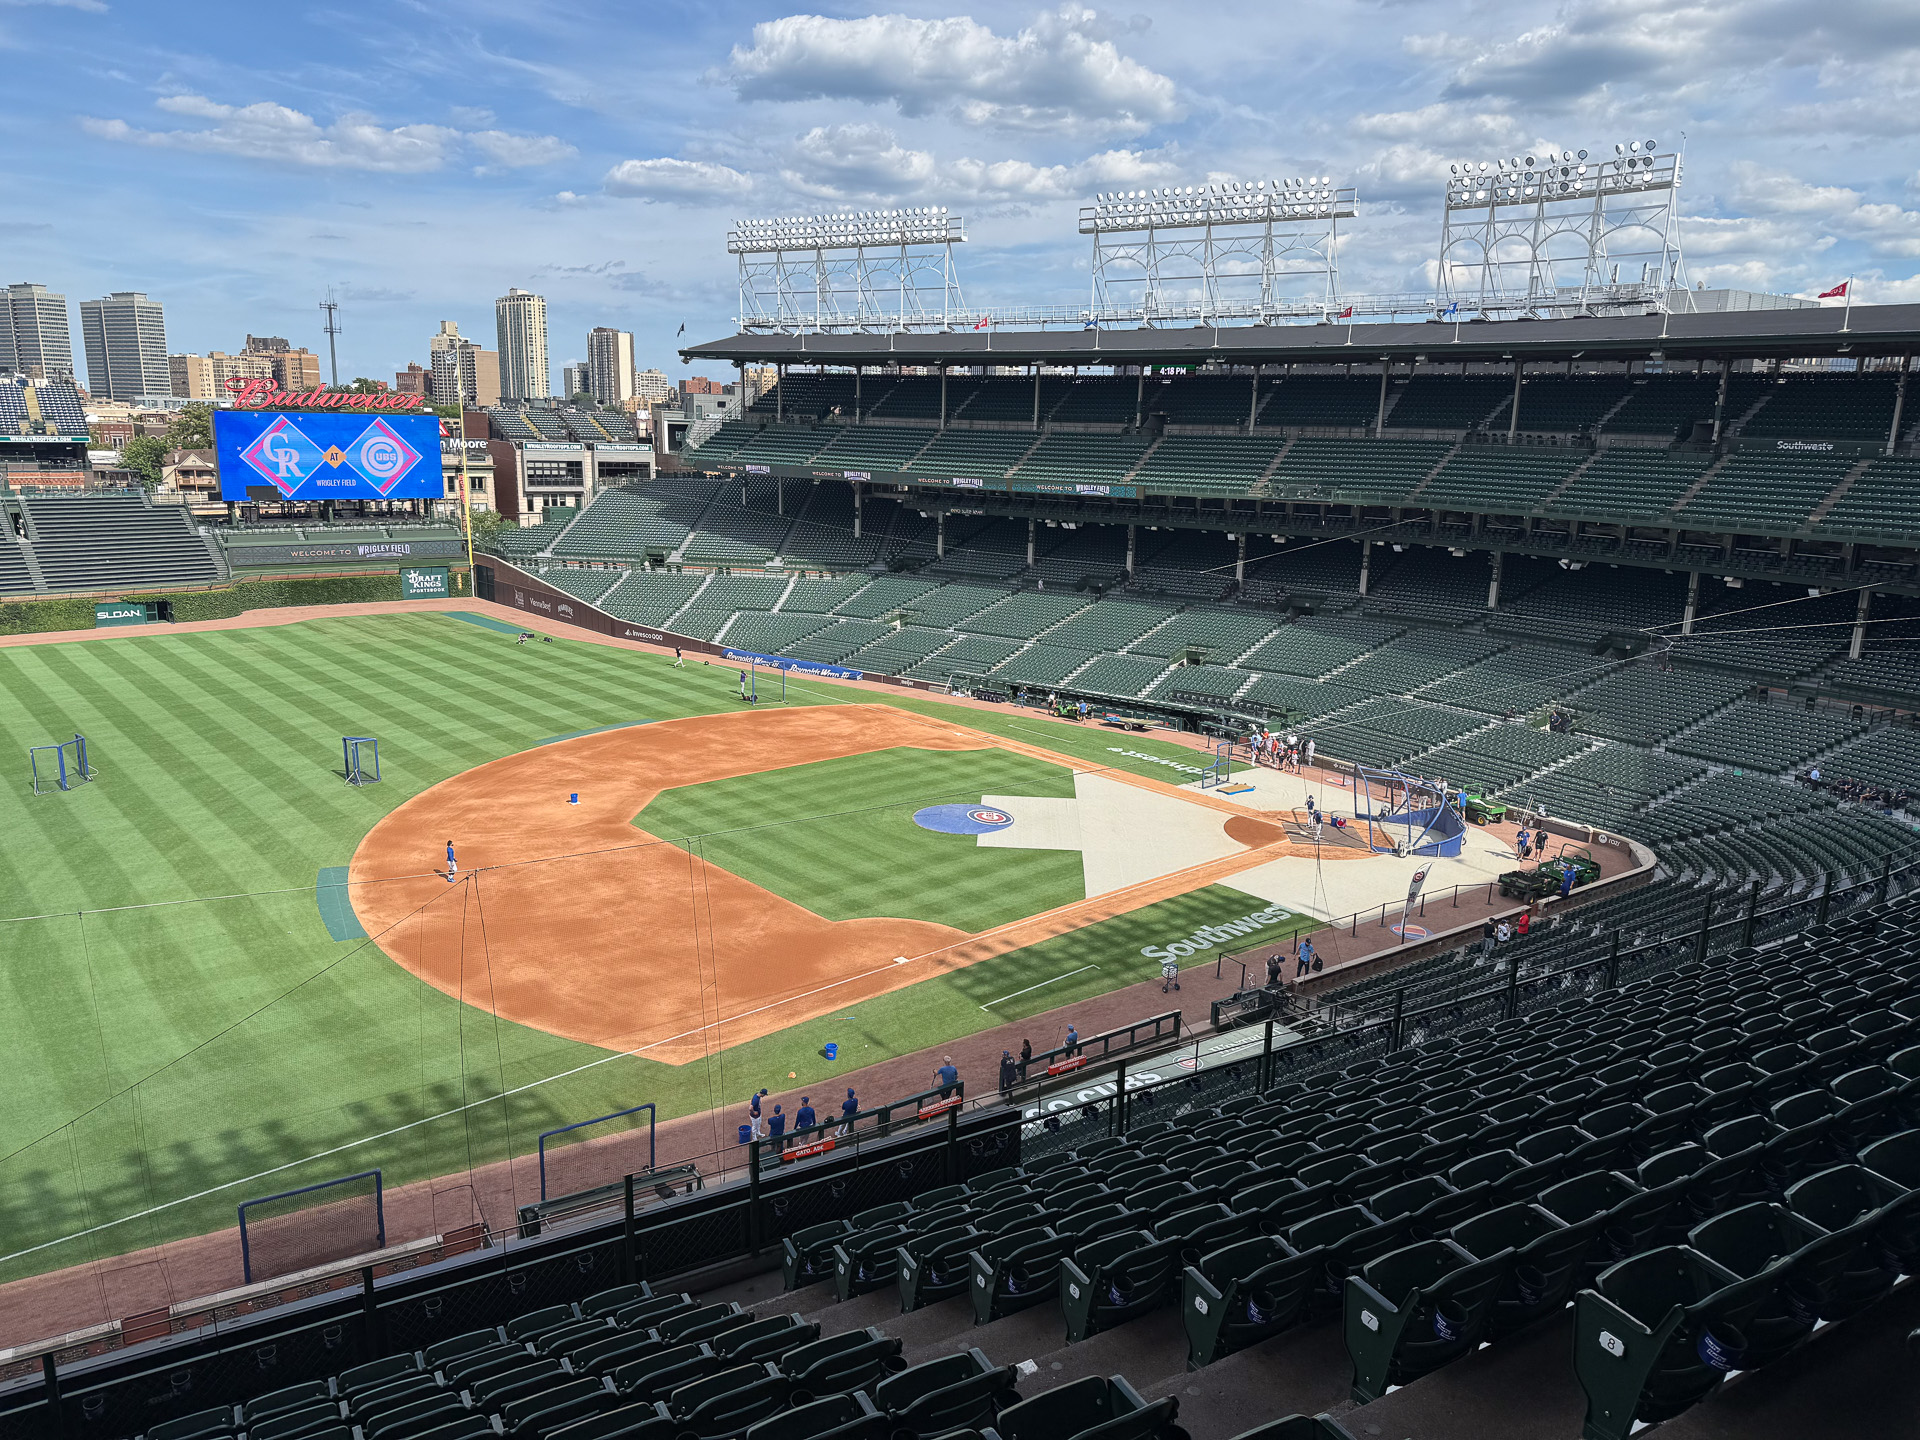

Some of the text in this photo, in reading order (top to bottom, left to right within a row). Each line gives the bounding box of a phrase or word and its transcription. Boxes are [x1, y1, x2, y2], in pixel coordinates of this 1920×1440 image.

[1160, 367, 1187, 375] 4:18 PM
[224, 377, 425, 409] Budweiser
[450, 438, 487, 448] Moore
[1777, 441, 1827, 450] Southwest
[330, 452, 338, 461] AT
[316, 479, 357, 487] WRIGLEY FIELD
[953, 477, 971, 487] WRIGLEY
[971, 478, 983, 487] FIELD
[1075, 484, 1097, 494] WRIGLEY
[1097, 485, 1110, 494] FIELD
[290, 549, 336, 557] WELCOME
[357, 545, 390, 556] WRIGLEY
[391, 544, 411, 554] FIELD
[408, 574, 442, 583] DRAFT
[97, 609, 141, 619] SLOAN
[632, 629, 652, 639] Invesco
[652, 633, 663, 641] QQQ
[726, 651, 754, 664] Reynolds
[789, 664, 821, 676] Reynolds
[1140, 903, 1300, 964] Southwest
[1198, 1301, 1204, 1310] 6
[1367, 1315, 1374, 1324] 7
[1607, 1338, 1616, 1350] 8
